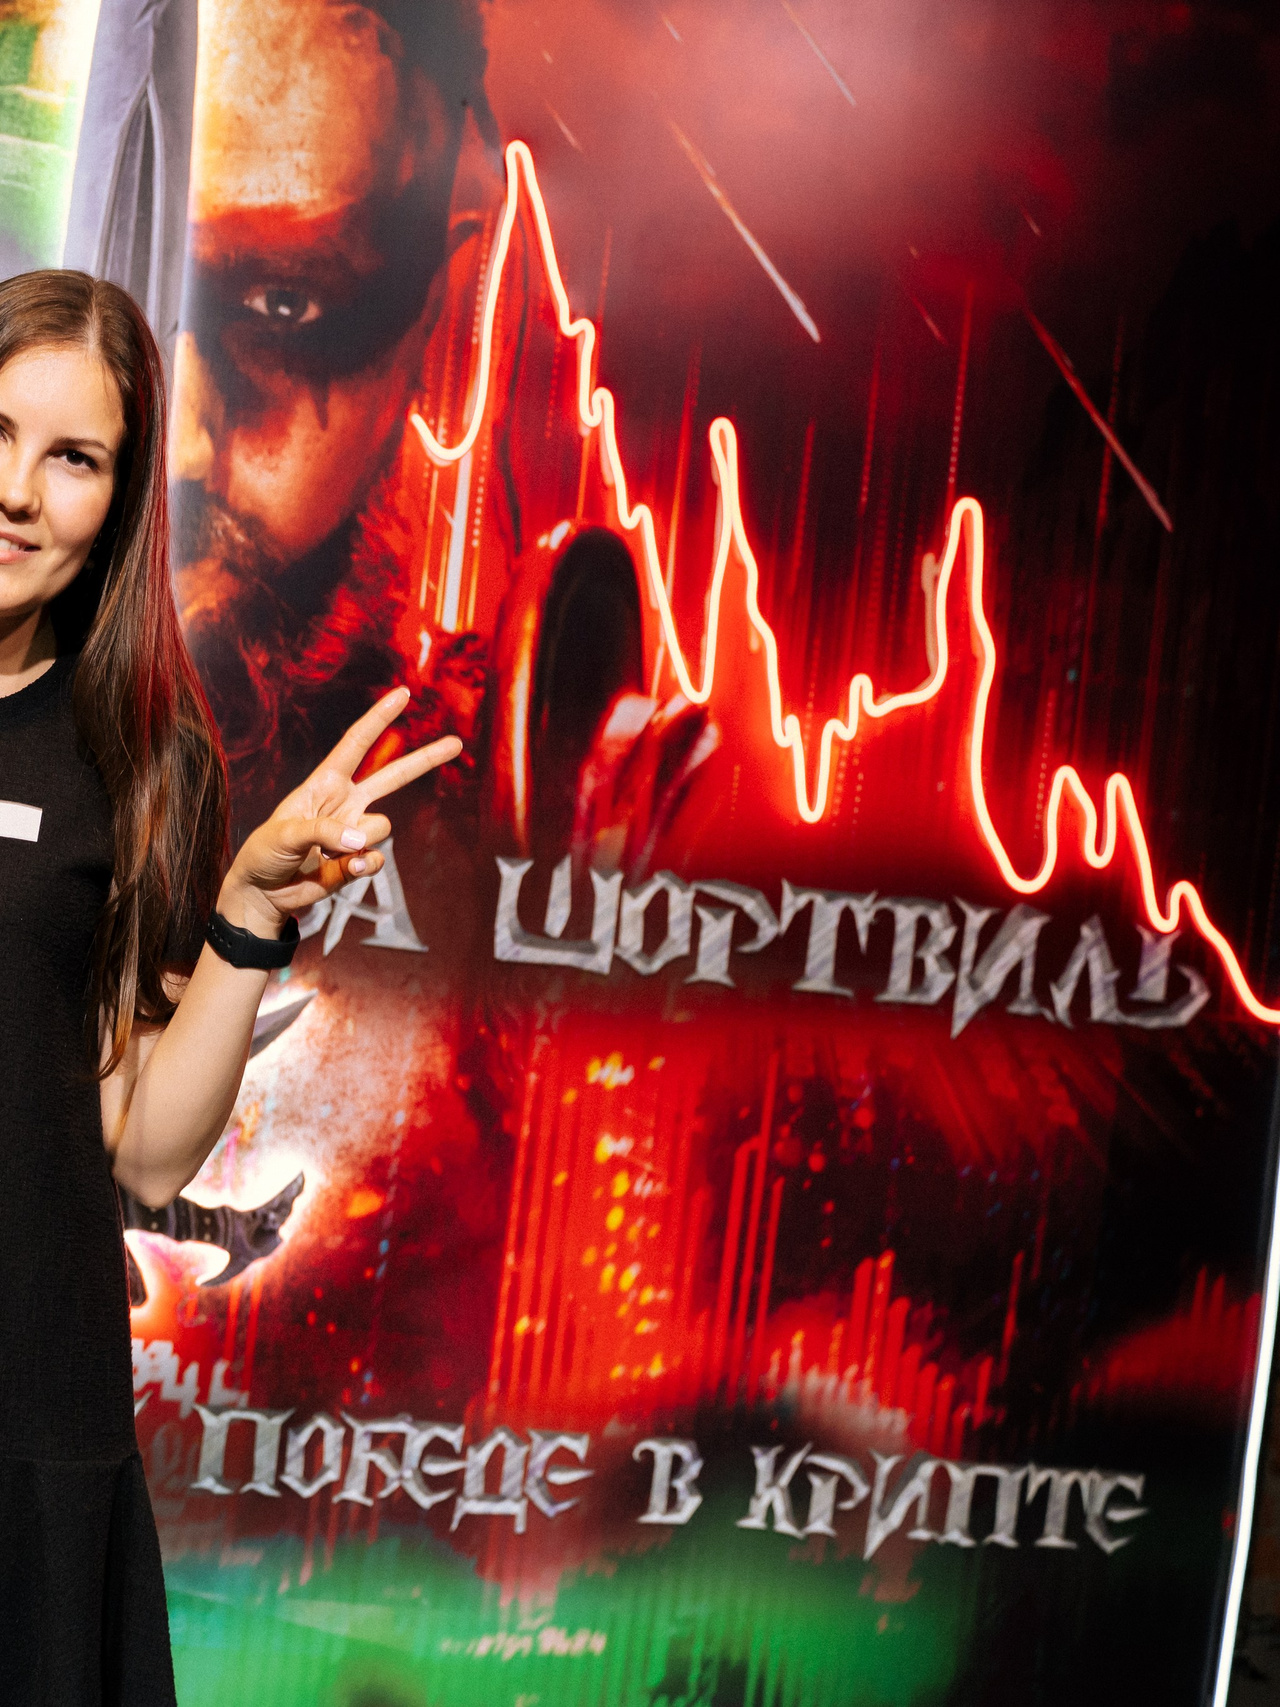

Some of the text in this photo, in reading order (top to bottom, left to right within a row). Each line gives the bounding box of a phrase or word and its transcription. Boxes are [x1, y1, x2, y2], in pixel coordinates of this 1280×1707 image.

[300, 837, 1211, 1039] А ШОРТВИЛЬ
[190, 1403, 594, 1533] ПОБЕДЕ
[632, 1437, 704, 1526] В
[736, 1441, 1150, 1561] КРИПТЕ
